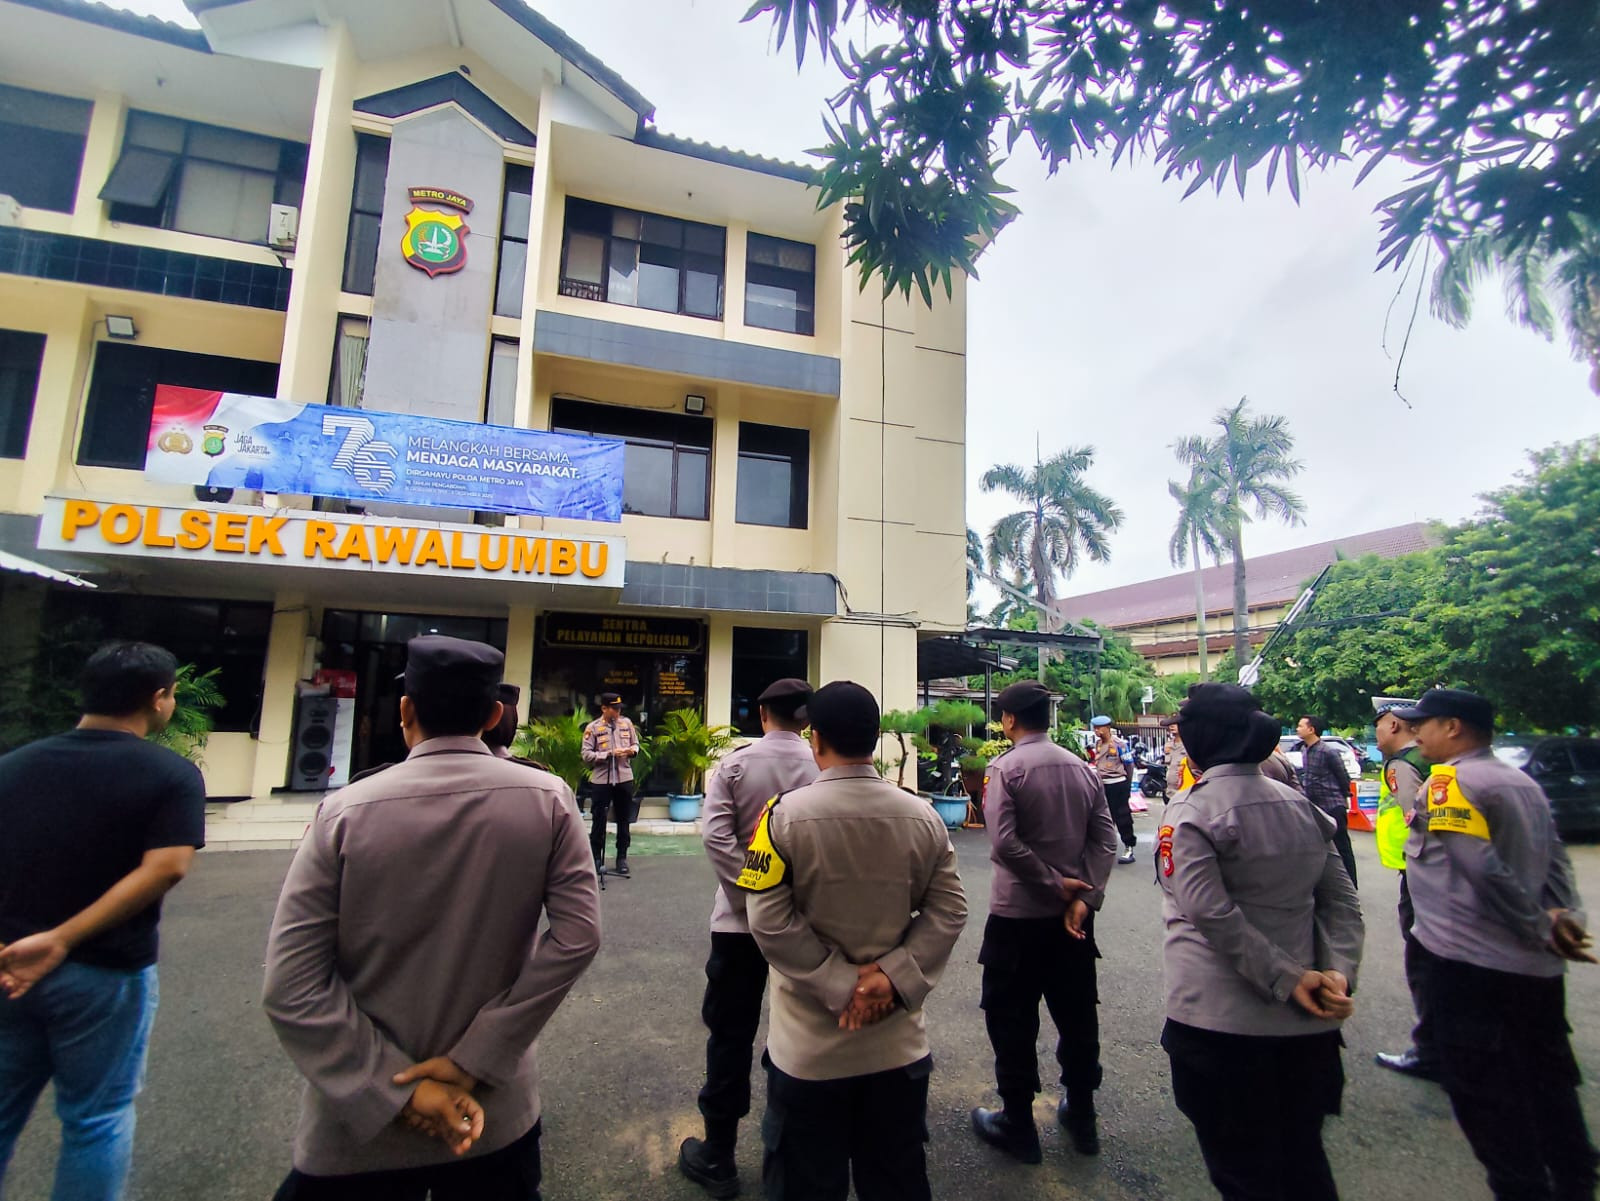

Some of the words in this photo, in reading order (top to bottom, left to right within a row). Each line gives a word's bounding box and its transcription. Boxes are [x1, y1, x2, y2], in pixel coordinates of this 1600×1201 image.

[413, 190, 445, 199] METRO
[446, 195, 467, 206] JAYA
[234, 433, 252, 445] JAGA
[322, 414, 399, 497] 76
[408, 436, 500, 457] MELANGKAH
[503, 446, 573, 466] BERSAMA,
[406, 450, 479, 469] MENJAGA
[483, 460, 581, 480] MASYARAKAT.
[406, 468, 451, 480] DIRGAHAYU
[452, 473, 478, 482] POLDA
[480, 476, 505, 485] METRO
[506, 479, 525, 487] JAYA
[61, 498, 287, 555] POLSEK
[302, 519, 609, 579] RAWALUMBU
[602, 618, 647, 631] SENTRA
[557, 629, 621, 644] PELAYANAN
[626, 633, 689, 646] KEPOLISIAN
